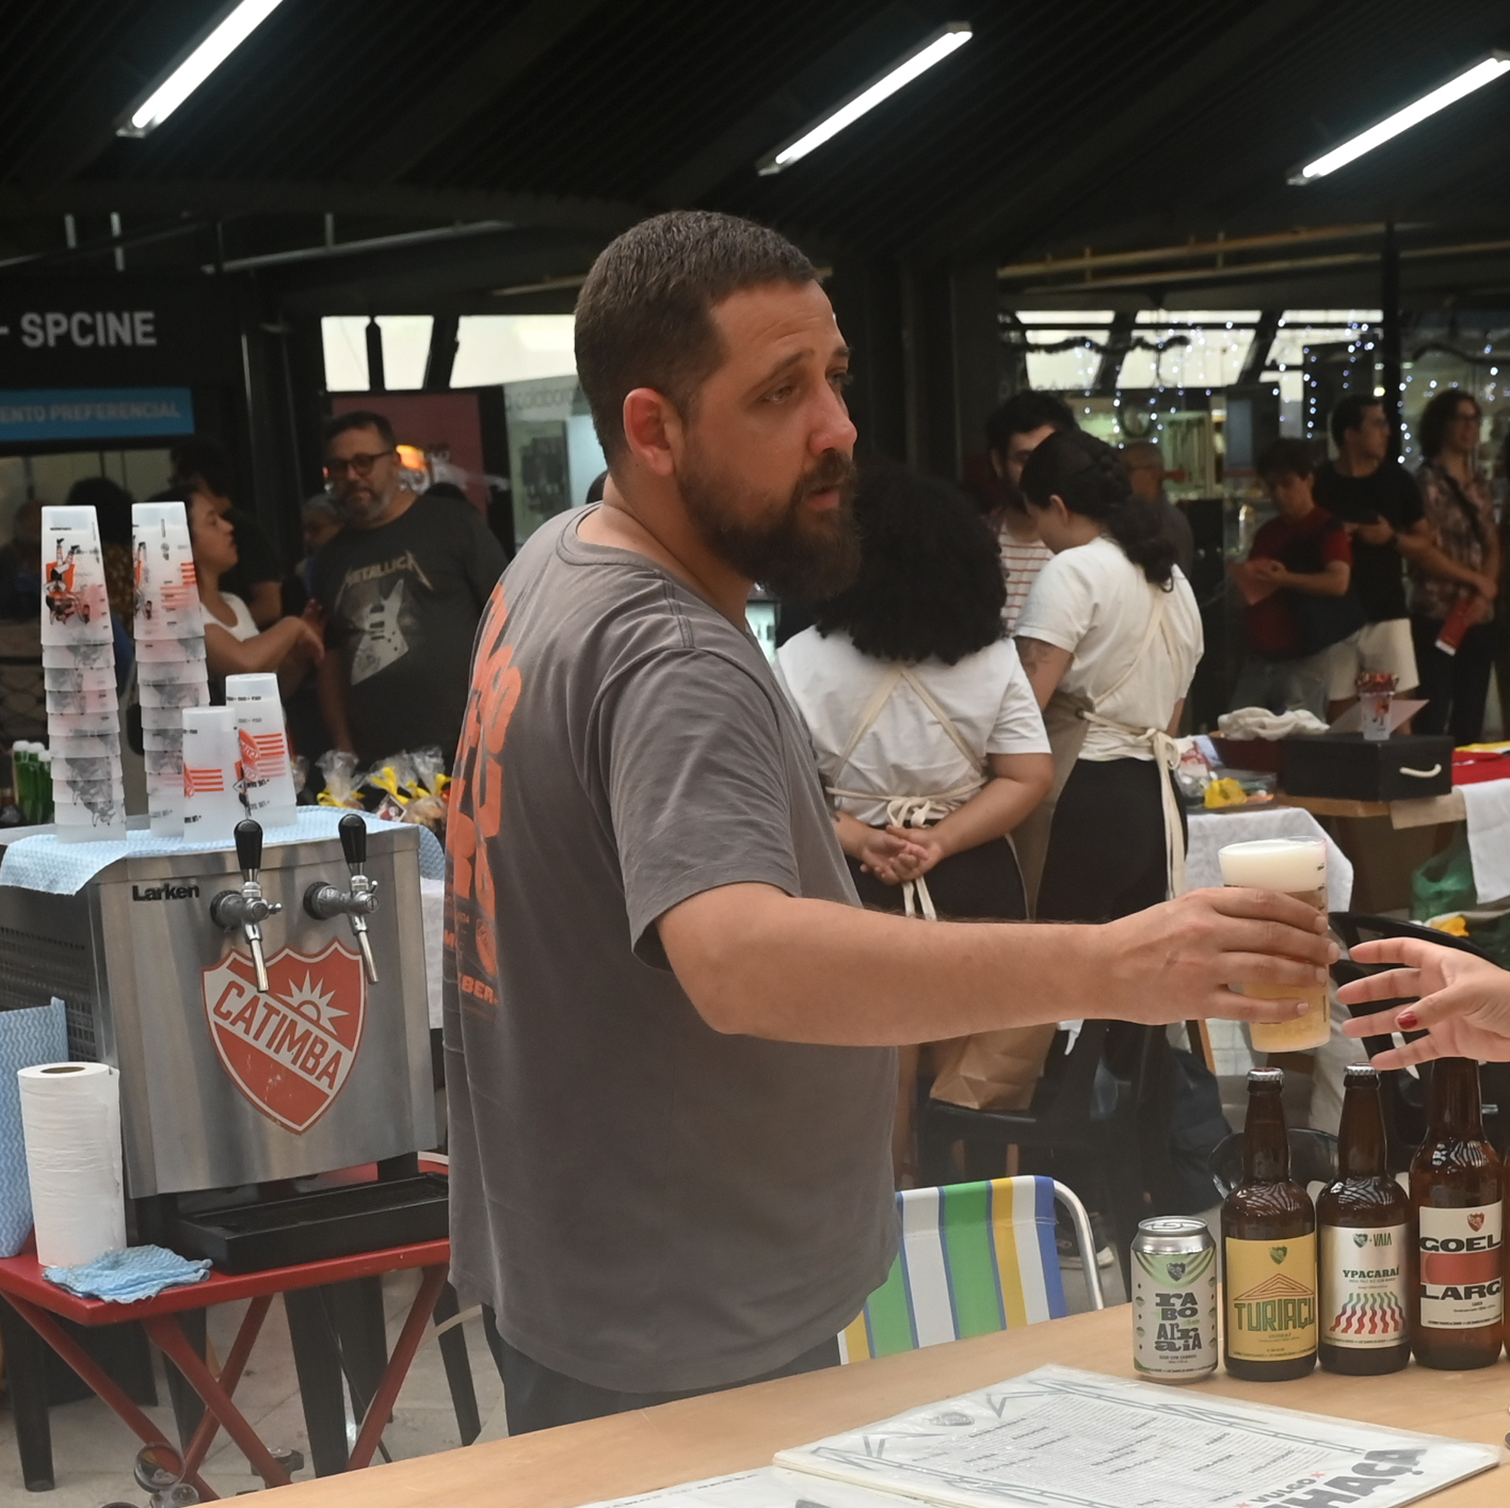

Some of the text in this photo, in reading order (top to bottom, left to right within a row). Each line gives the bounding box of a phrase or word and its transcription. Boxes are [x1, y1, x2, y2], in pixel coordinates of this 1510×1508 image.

[20, 310, 157, 348] SPCINE
[48, 399, 182, 423] PREFERENCIAL
[131, 882, 200, 902] Larken
[213, 979, 344, 1091] CATIMBA
[1342, 1264, 1400, 1279] YPACARAÍ
[1233, 1296, 1316, 1332] TURIAÇU
[1248, 1478, 1318, 1505] VULGO
